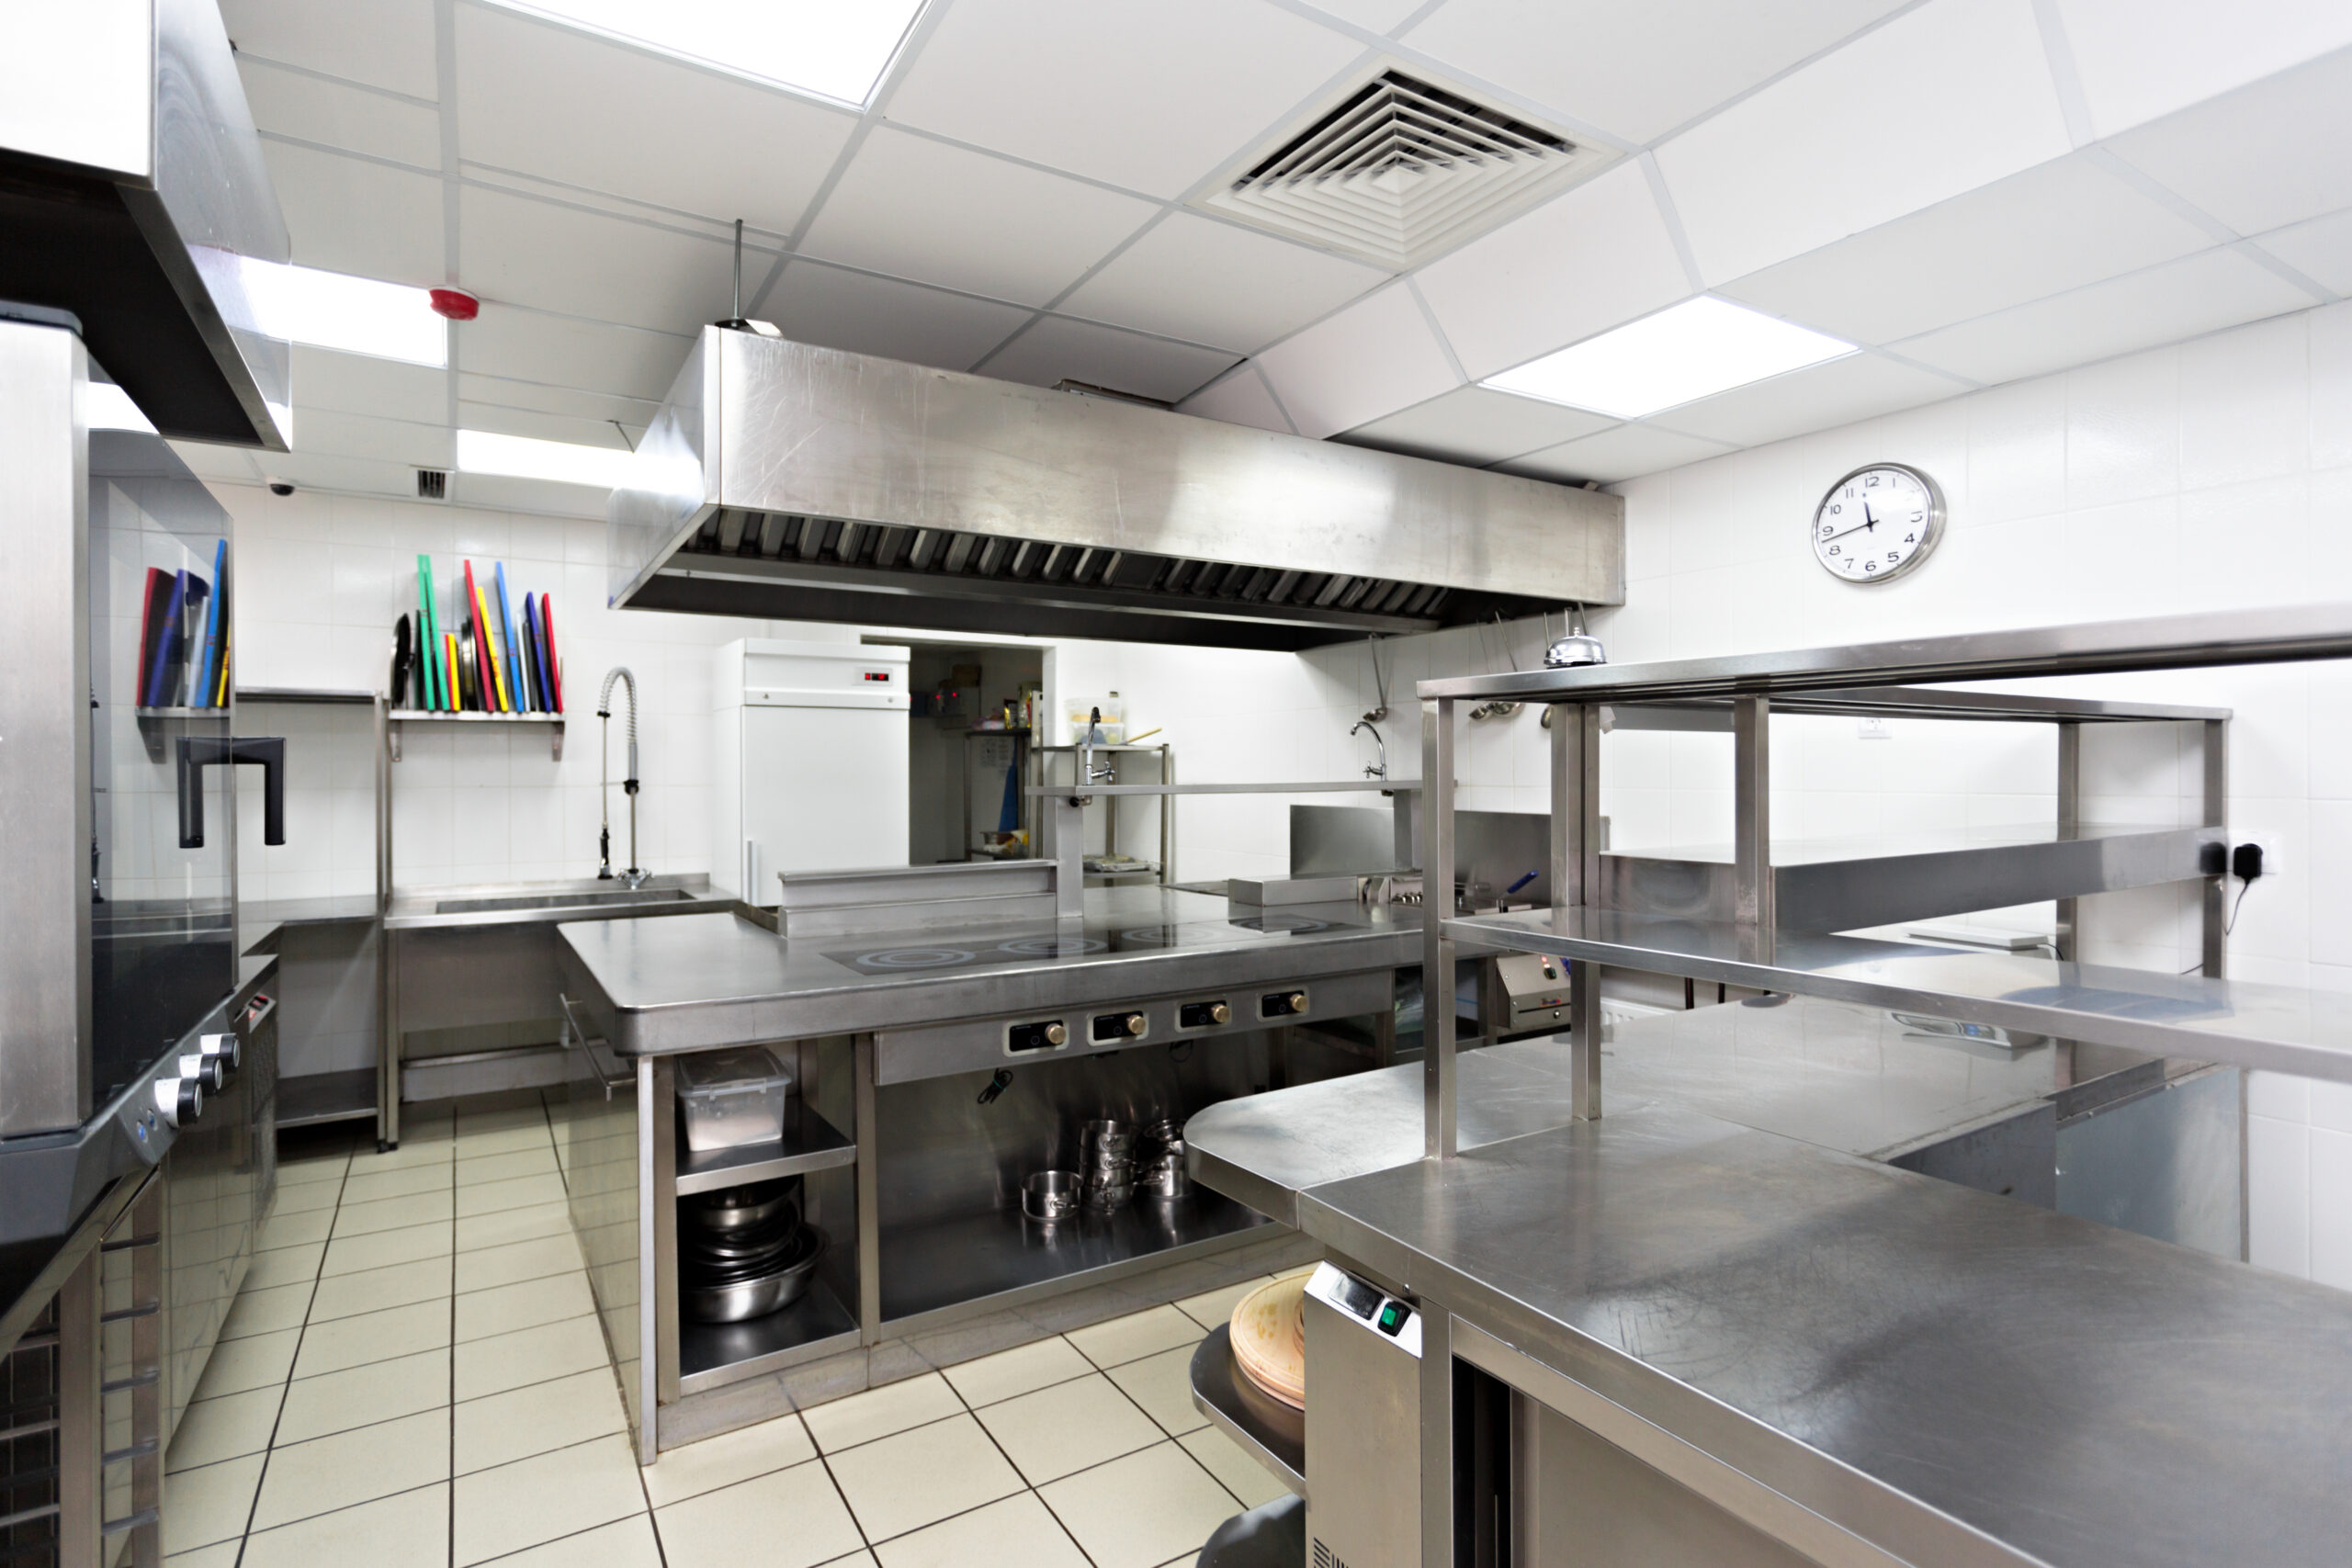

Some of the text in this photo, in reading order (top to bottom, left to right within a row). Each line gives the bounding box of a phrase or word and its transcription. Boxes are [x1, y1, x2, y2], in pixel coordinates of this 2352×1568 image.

[1865, 477, 1880, 488] 12
[1846, 488, 1854, 499] 11
[1830, 504, 1841, 515] 10
[1823, 525, 1834, 536] 9
[1904, 533, 1916, 544] 4
[1829, 545, 1841, 556] 8
[1887, 551, 1900, 563] 5
[1844, 558, 1854, 570] 7
[1865, 560, 1876, 572] 6
